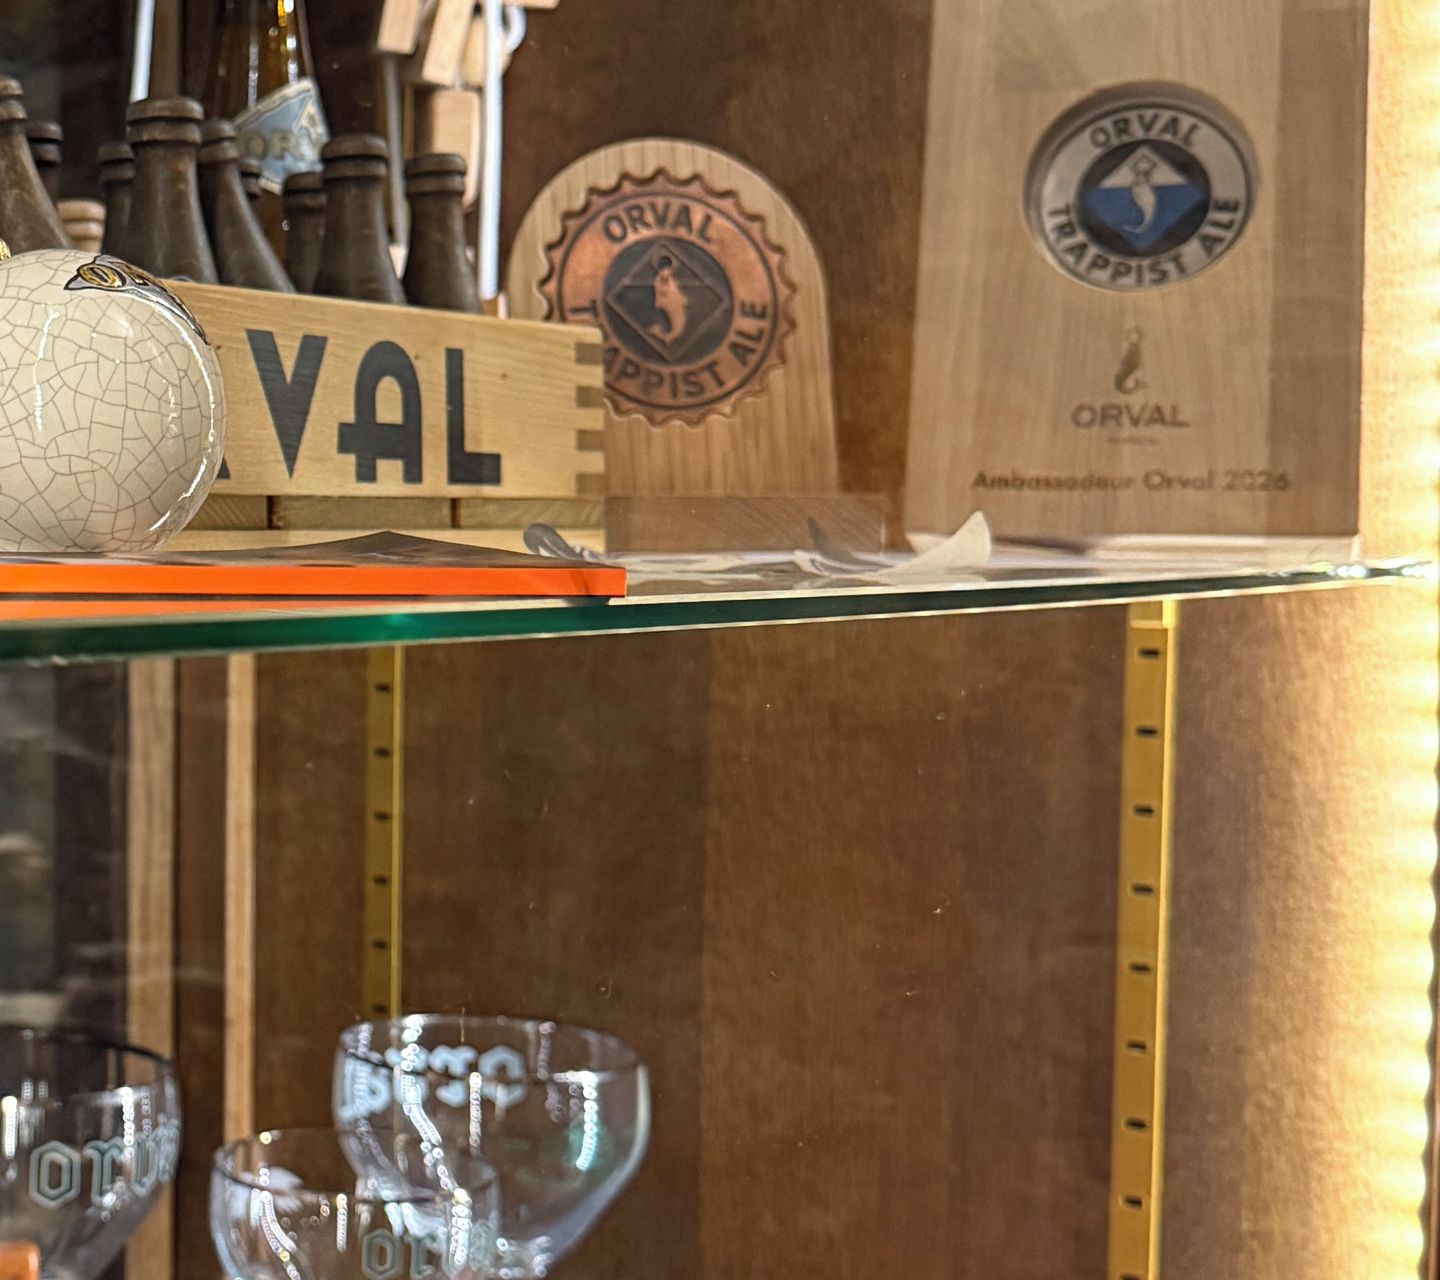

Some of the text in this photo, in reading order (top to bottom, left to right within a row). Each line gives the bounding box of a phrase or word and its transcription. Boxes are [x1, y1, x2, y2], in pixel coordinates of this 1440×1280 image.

[1089, 111, 1199, 149] ORVAL
[602, 201, 715, 244] ORVAL
[1048, 197, 1242, 286] TRAPPIST ALE
[568, 299, 768, 400] TAPPIST ALE
[216, 327, 502, 486] VAL
[1070, 403, 1191, 429] ORVAL
